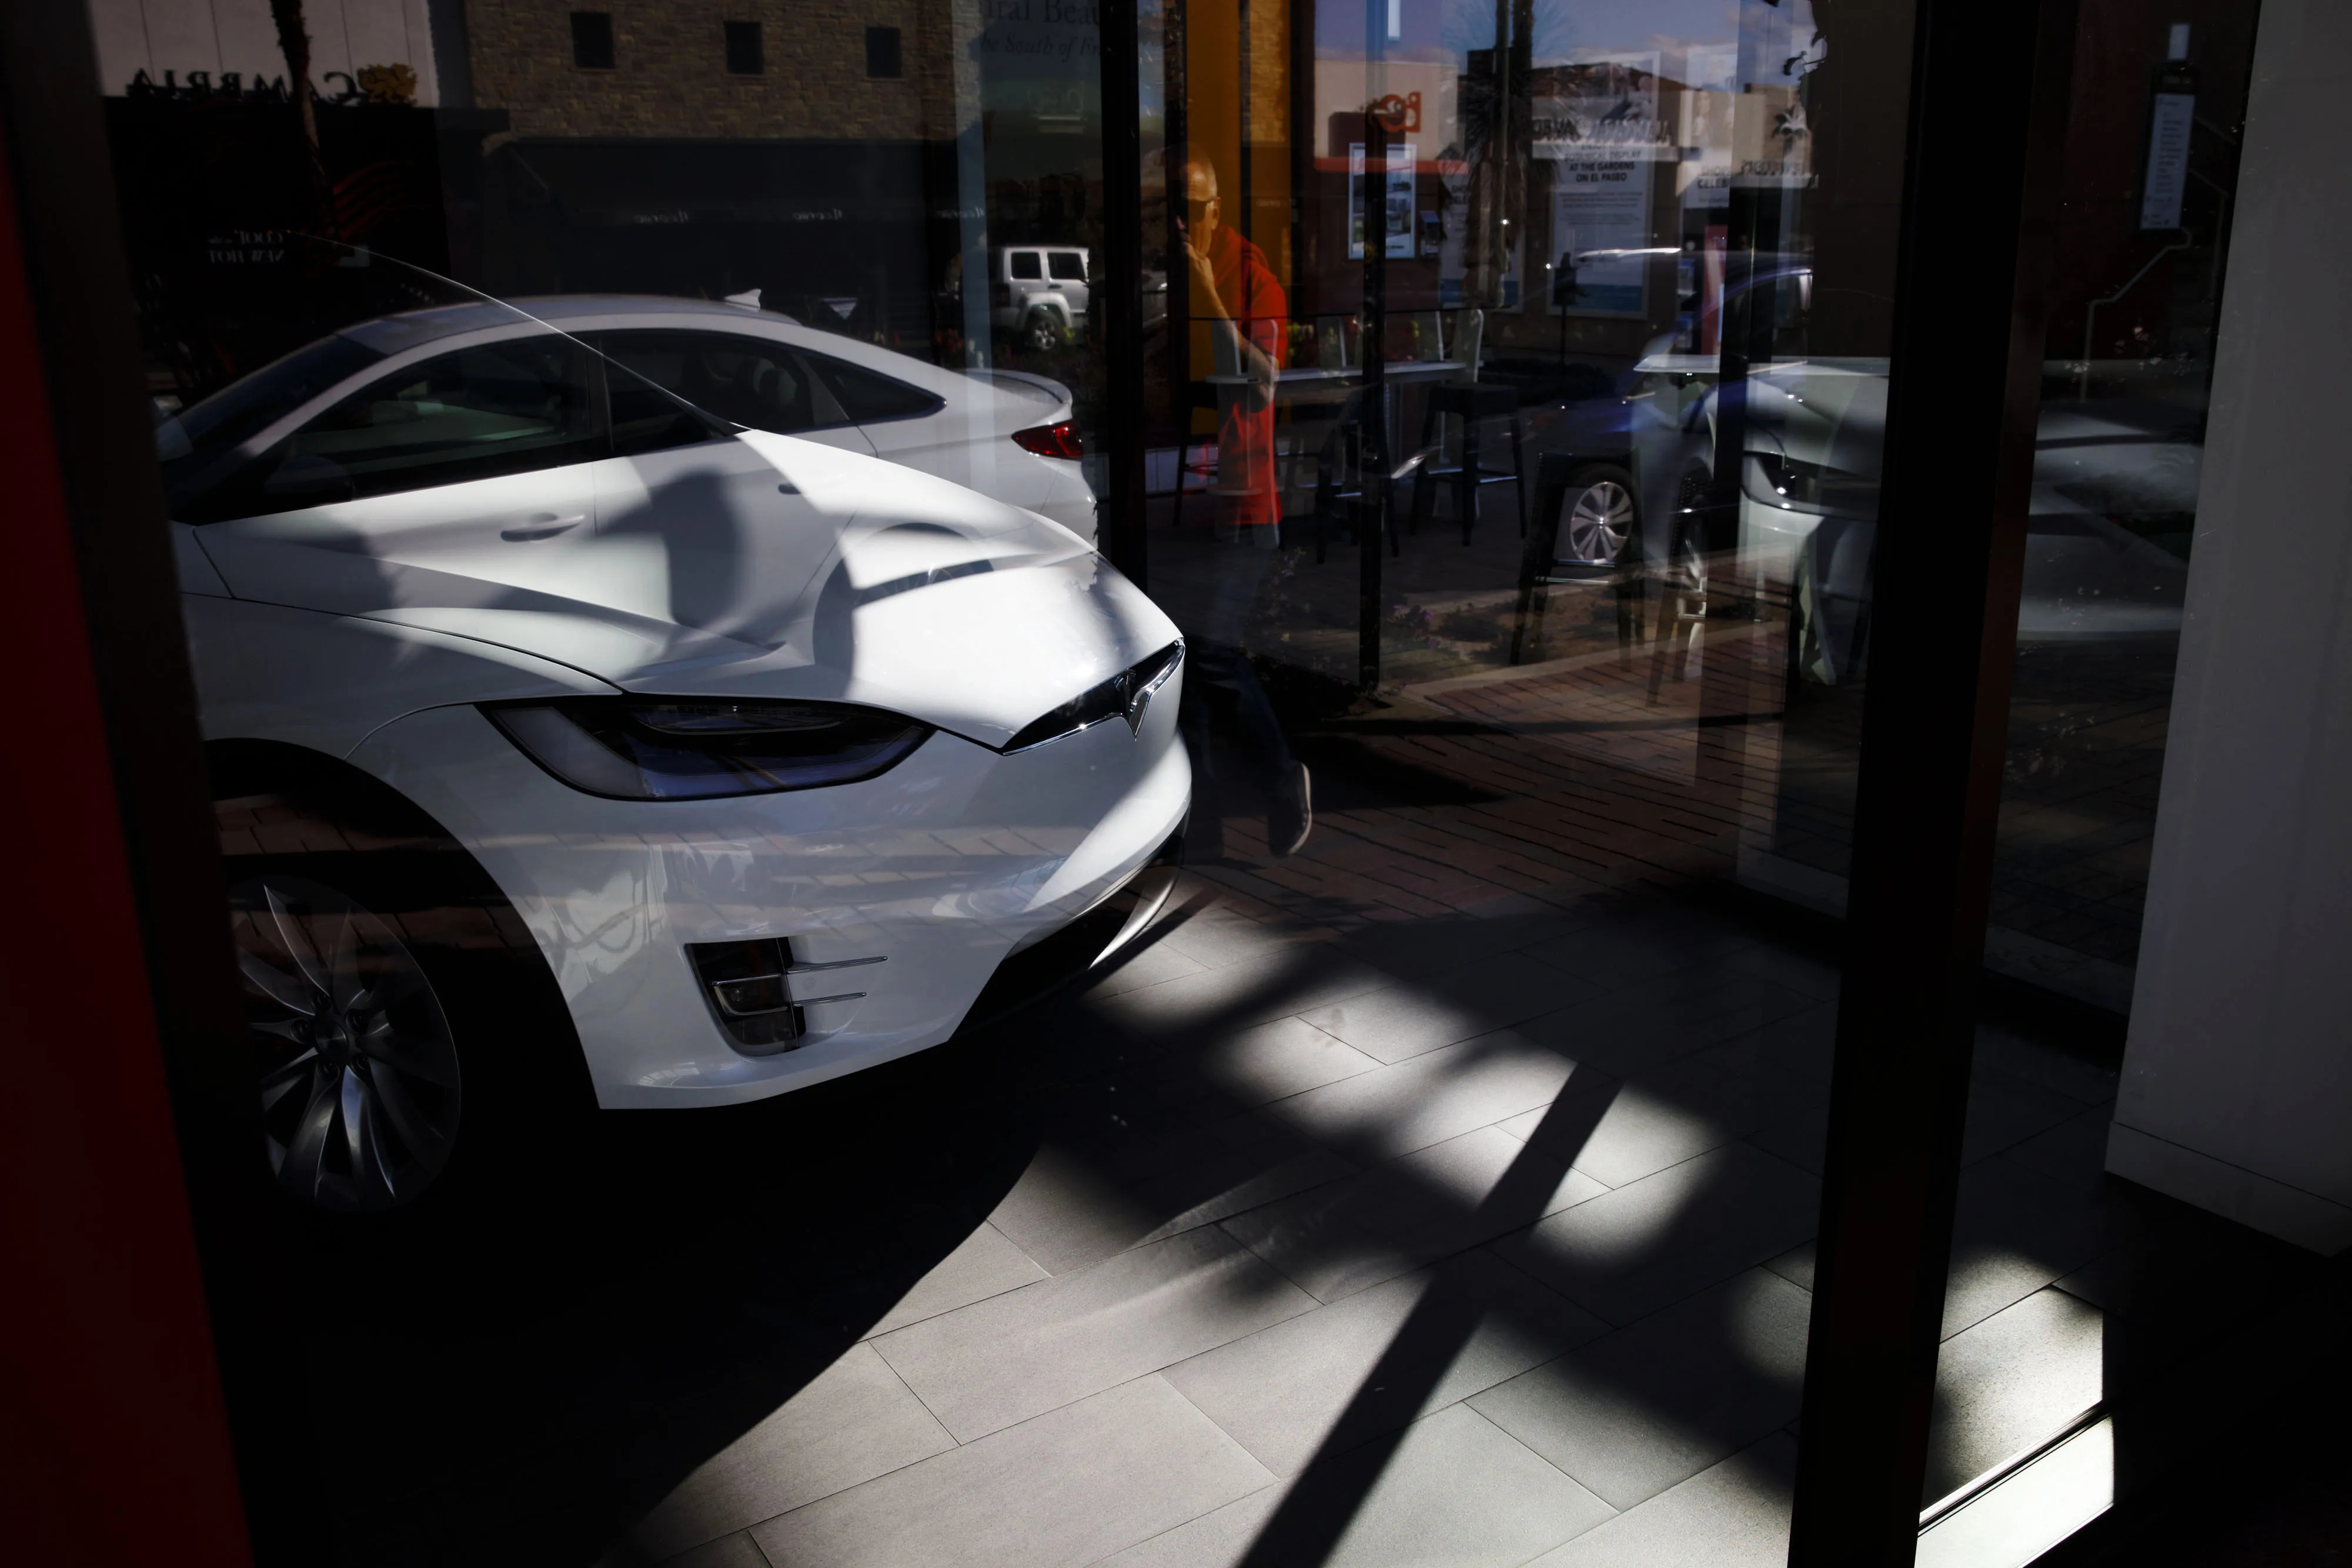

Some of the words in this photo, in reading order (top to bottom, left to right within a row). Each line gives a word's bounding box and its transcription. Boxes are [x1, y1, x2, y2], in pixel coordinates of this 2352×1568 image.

[1569, 163, 1578, 171] AT
[1582, 162, 1595, 171] THE
[1598, 161, 1635, 170] GARDENS
[1576, 173, 1588, 182] ON
[1591, 173, 1598, 182] EL
[1602, 172, 1627, 181] PASEO
